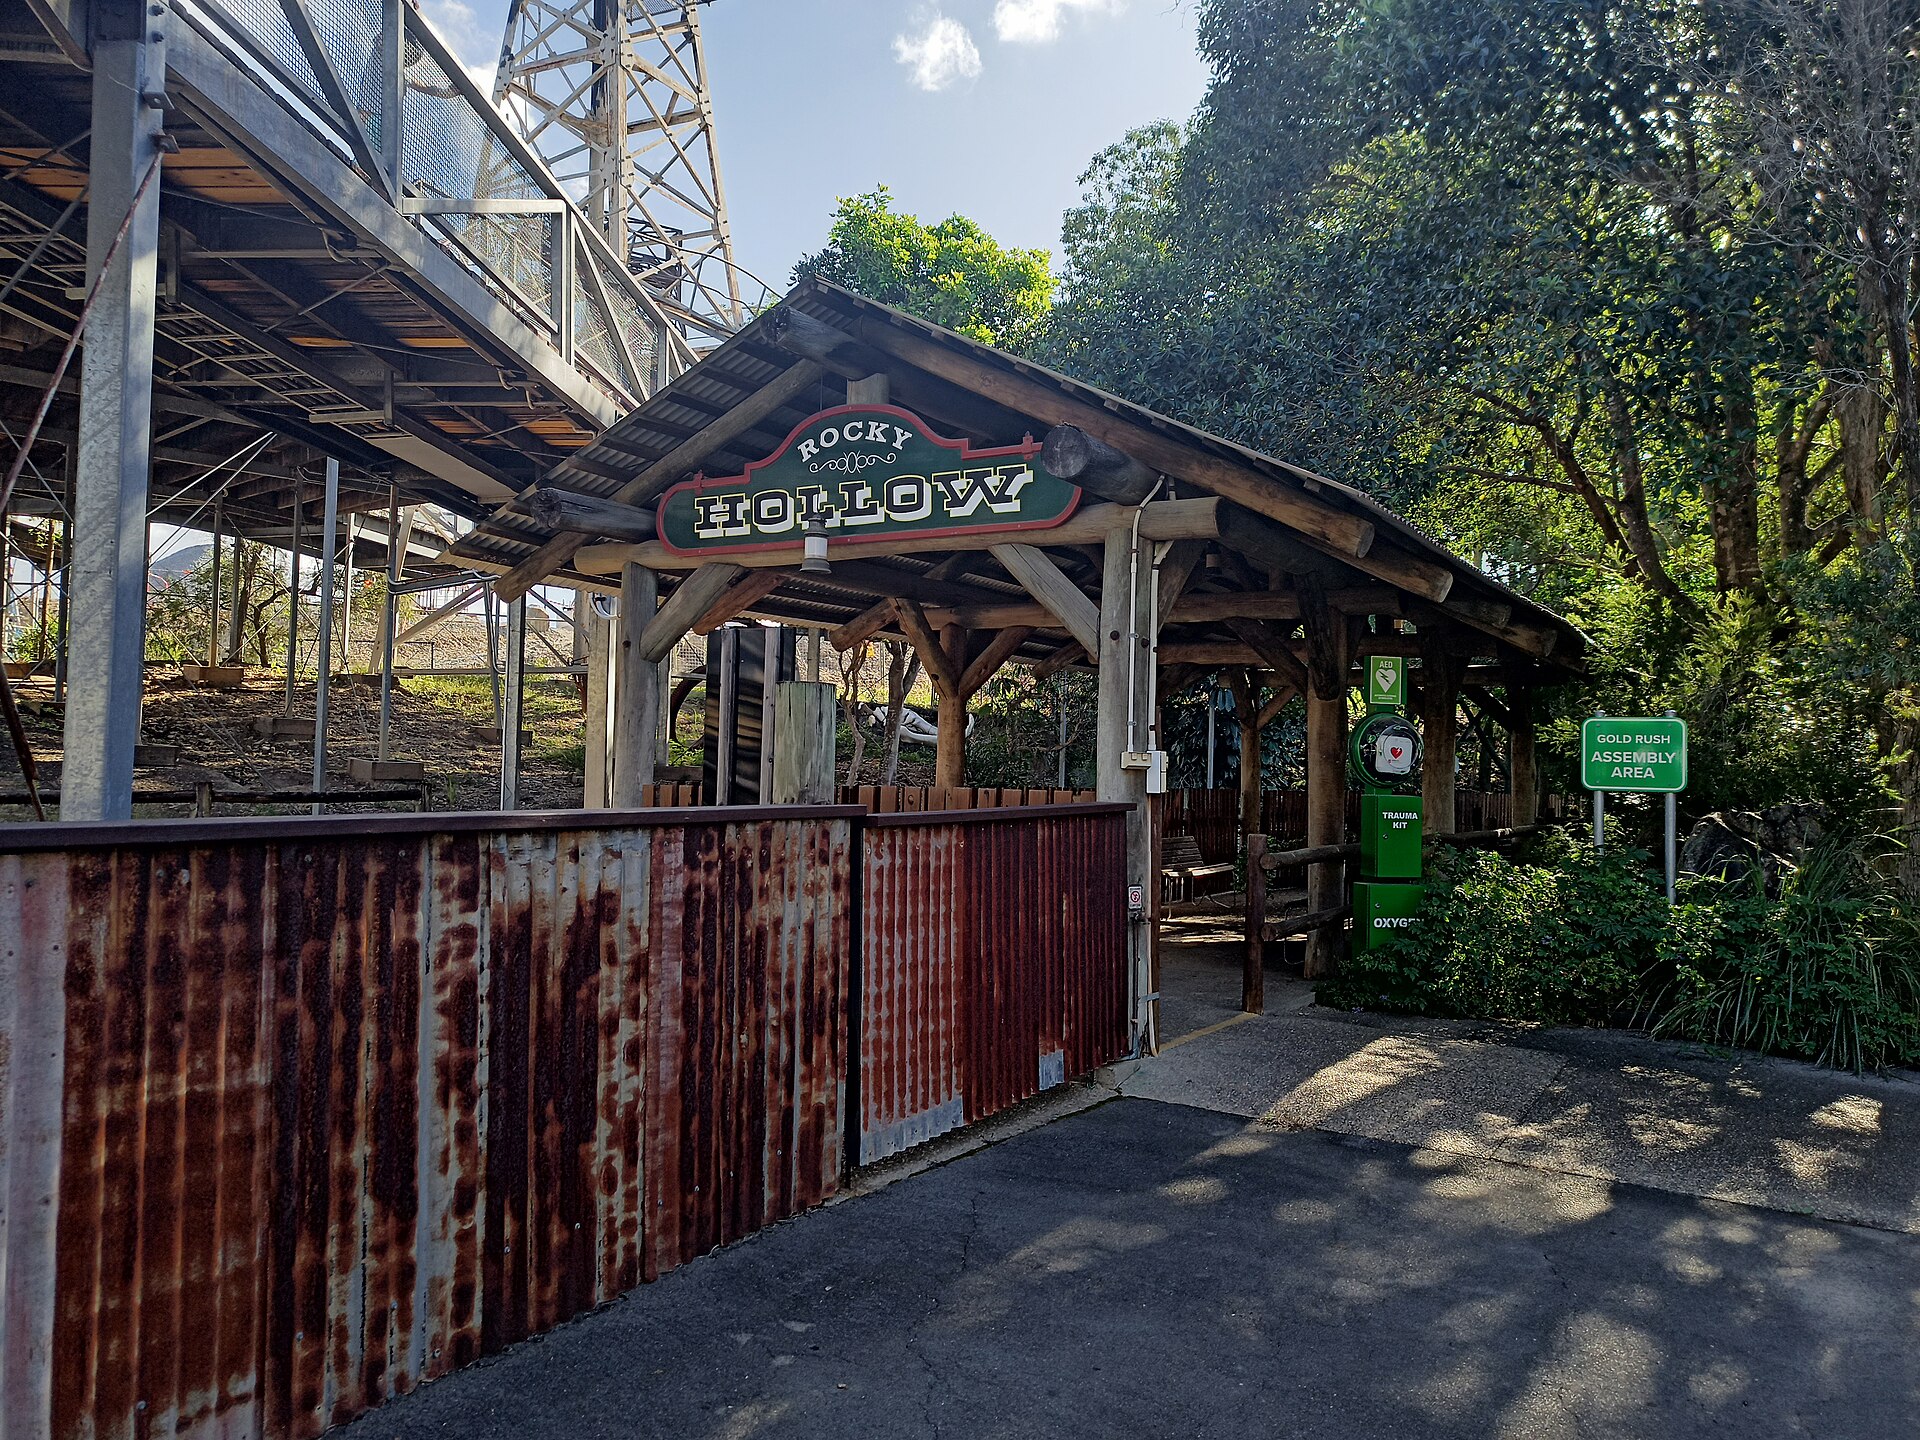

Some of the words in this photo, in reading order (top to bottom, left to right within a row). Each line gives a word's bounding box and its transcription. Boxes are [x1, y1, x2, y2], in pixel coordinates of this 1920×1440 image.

[797, 420, 913, 462] ROCKY
[695, 464, 1033, 538] HOLLOW
[1379, 660, 1393, 669] AED
[1597, 734, 1632, 743] GOLD
[1635, 735, 1670, 743] RUSH
[1591, 751, 1676, 763] ASSEMBLY
[1611, 767, 1655, 778] AREA
[1382, 811, 1418, 819] TRAUMA
[1373, 917, 1424, 928] OXYG
